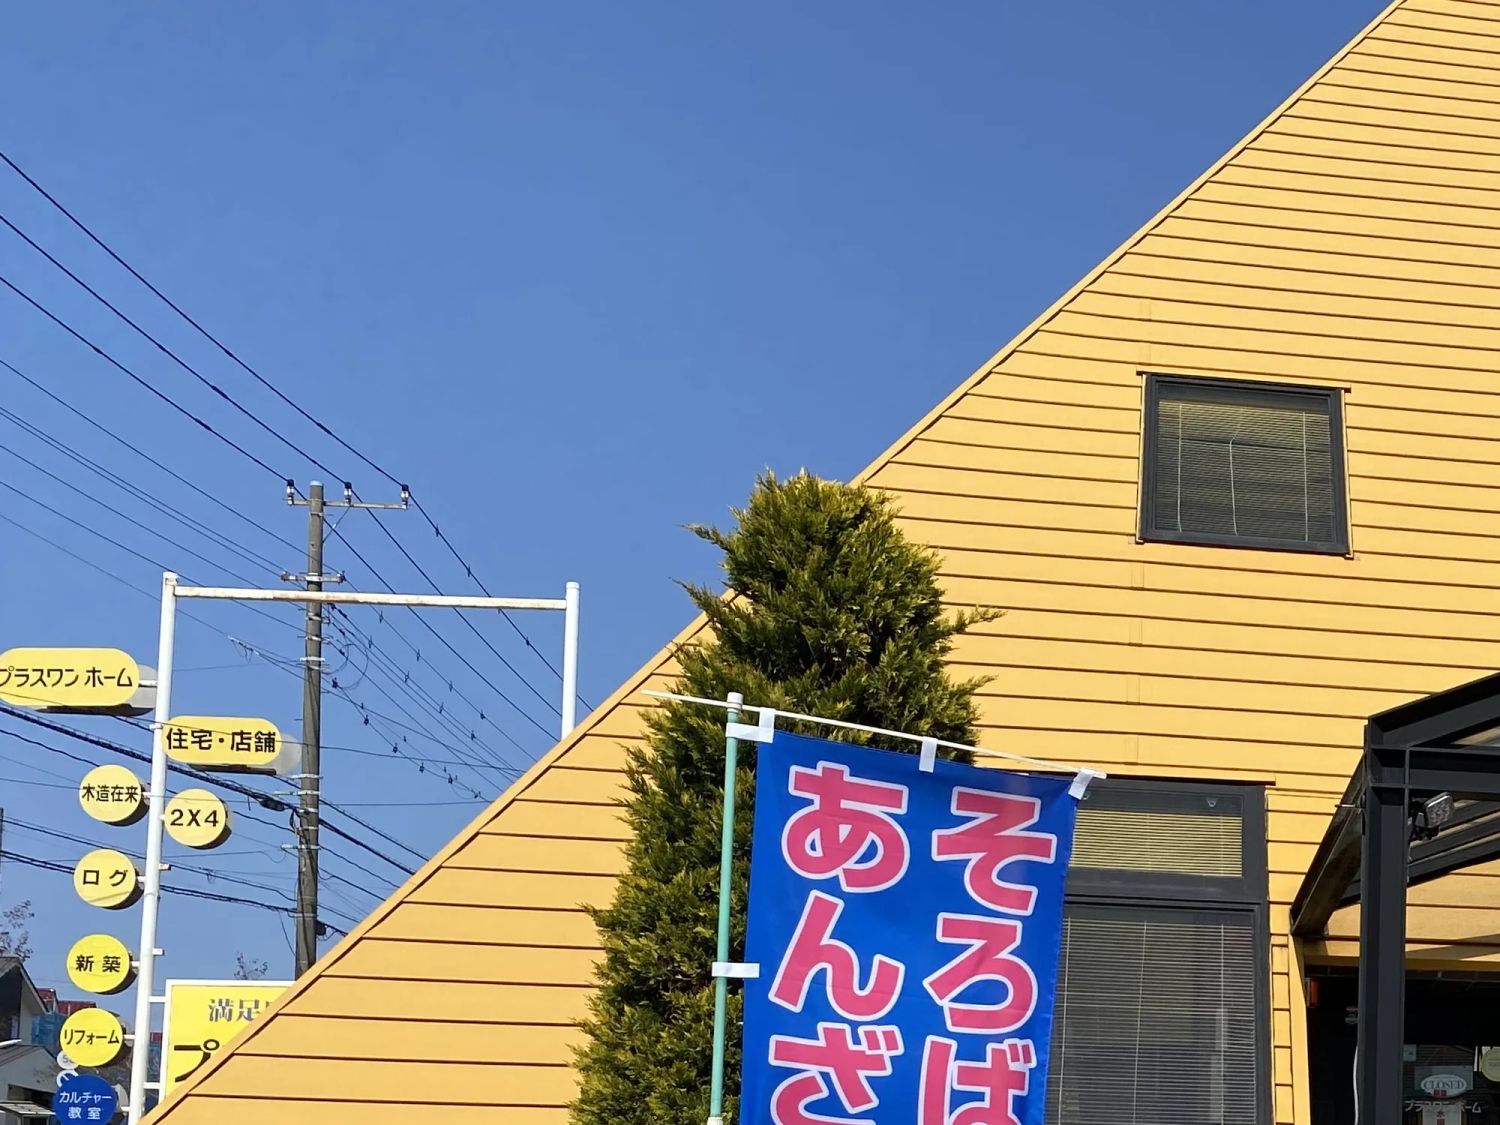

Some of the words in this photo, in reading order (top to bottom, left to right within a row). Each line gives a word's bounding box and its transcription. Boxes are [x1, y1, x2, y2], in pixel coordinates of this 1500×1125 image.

[166, 728, 276, 753] 住宅・店舗
[82, 784, 139, 803] 木造在来
[83, 869, 128, 888] ログ
[75, 955, 121, 973] 新築
[64, 1030, 120, 1046] リフォーム
[1423, 1079, 1465, 1090] CLOSED
[59, 1091, 113, 1104] カルチャー
[68, 1106, 102, 1120] 教室
